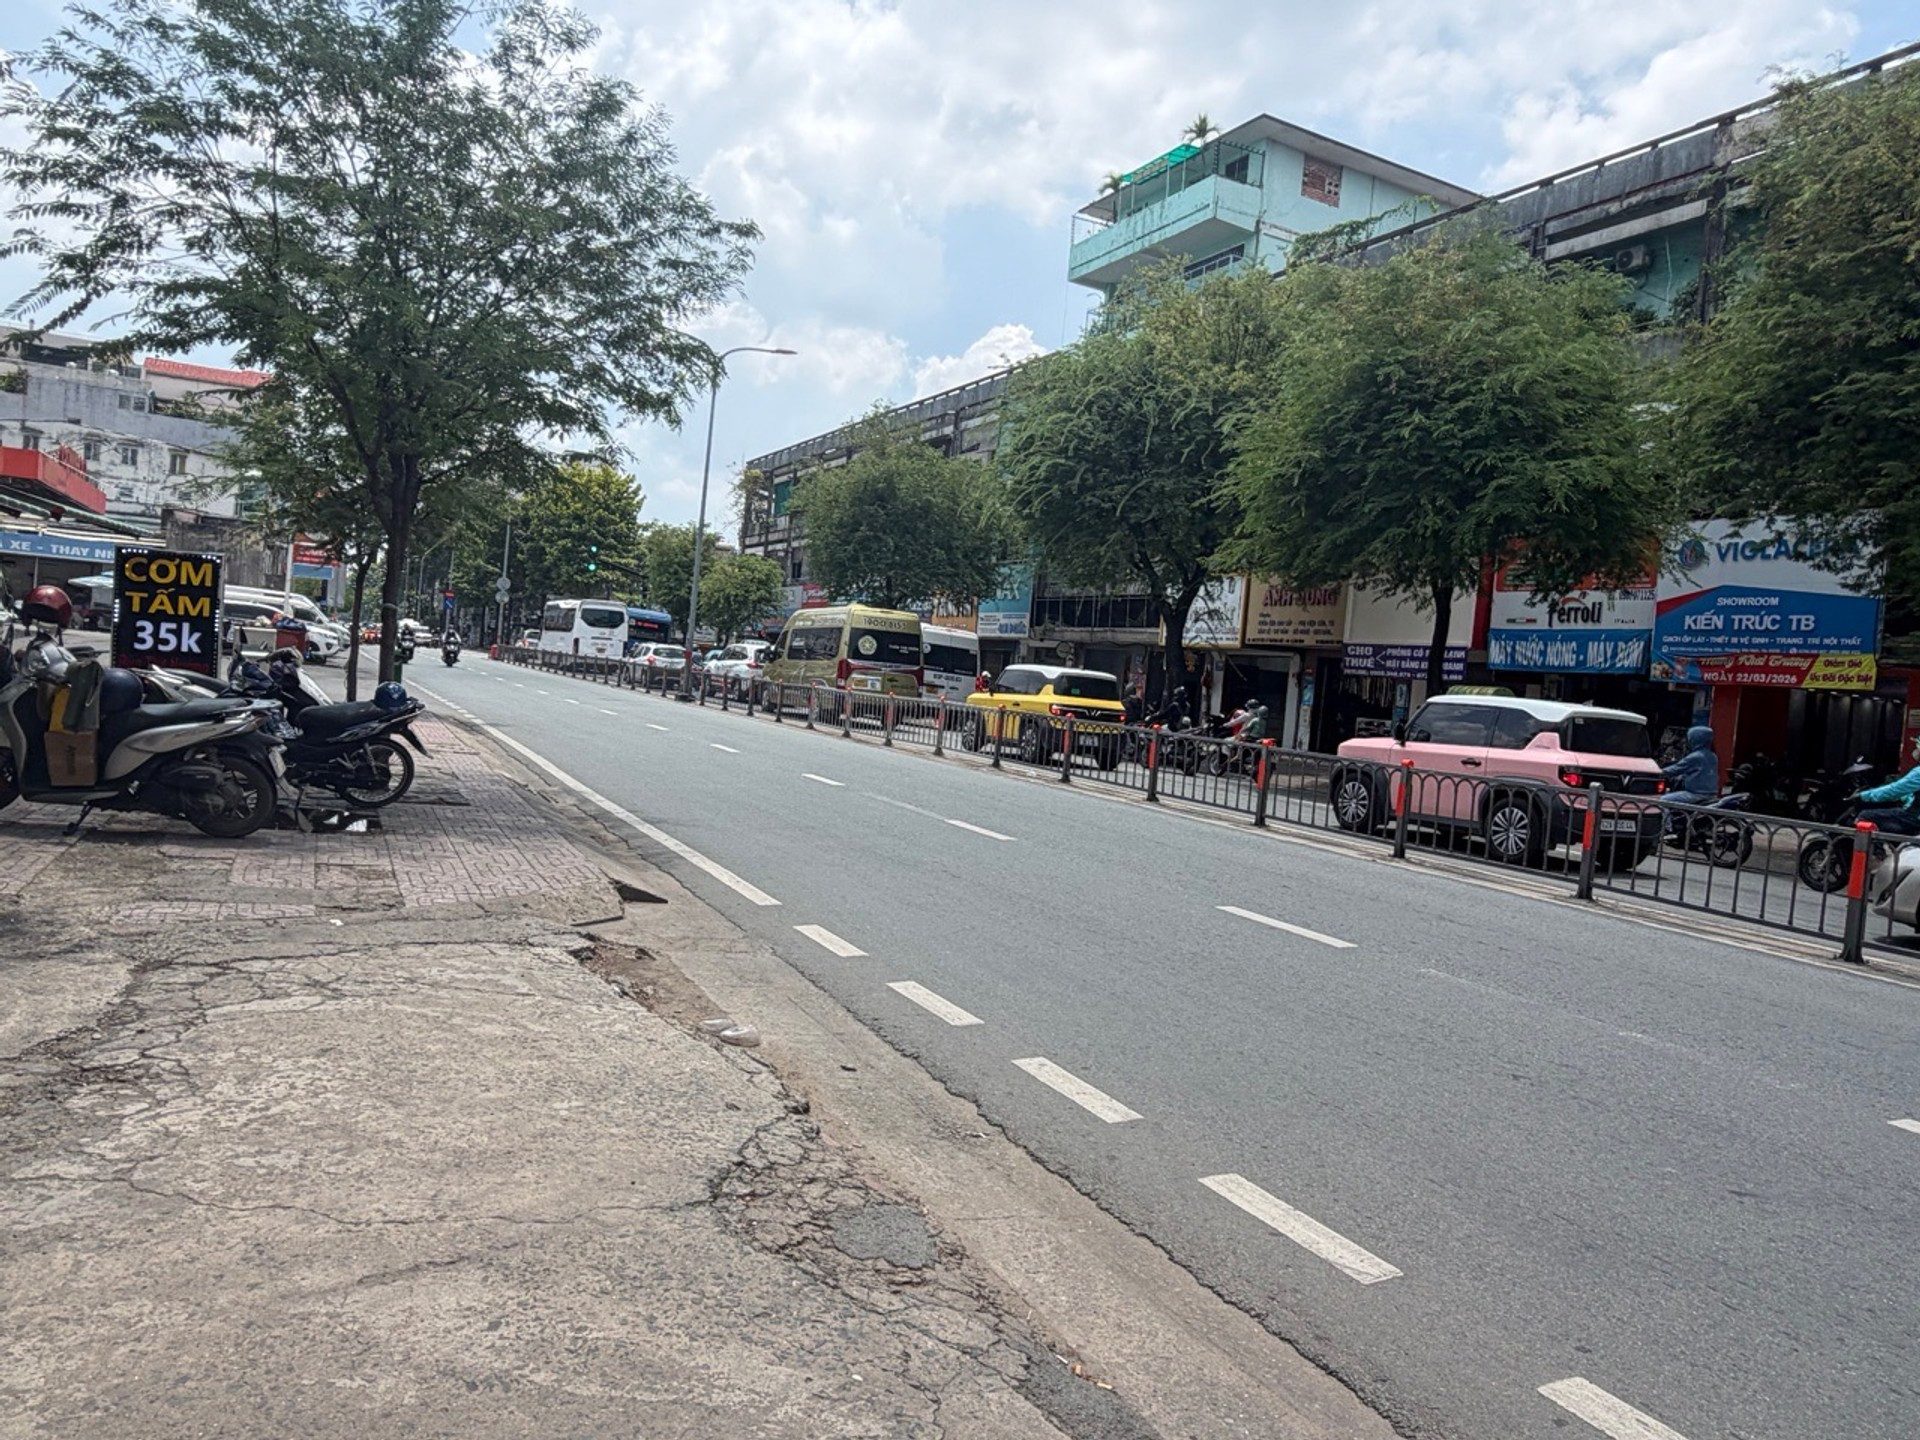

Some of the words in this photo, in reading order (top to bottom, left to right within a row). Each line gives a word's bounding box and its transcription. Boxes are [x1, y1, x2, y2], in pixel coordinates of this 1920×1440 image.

[10, 541, 31, 551] XE
[50, 544, 90, 556] THAY
[94, 549, 115, 559] NH
[124, 556, 213, 587] CƠM
[125, 588, 211, 618] TẤM
[1716, 596, 1779, 606] SHOWROOM
[1547, 601, 1604, 628] ferroli
[1684, 610, 1724, 630] KIẾN
[1731, 611, 1781, 631] TRÚC
[1788, 614, 1815, 631] TB
[133, 619, 202, 653] 35k
[1776, 637, 1803, 645] TRANG
[1347, 645, 1374, 656] CHO
[1489, 634, 1513, 665] MÁY
[1515, 633, 1545, 666] NƯỚC
[1545, 634, 1578, 667] NÓNG
[1586, 634, 1614, 668] MÁY
[1344, 656, 1375, 668] THUÊ
[1703, 670, 1734, 681] NGÀY
[1736, 673, 1797, 683] 22/03/2026
